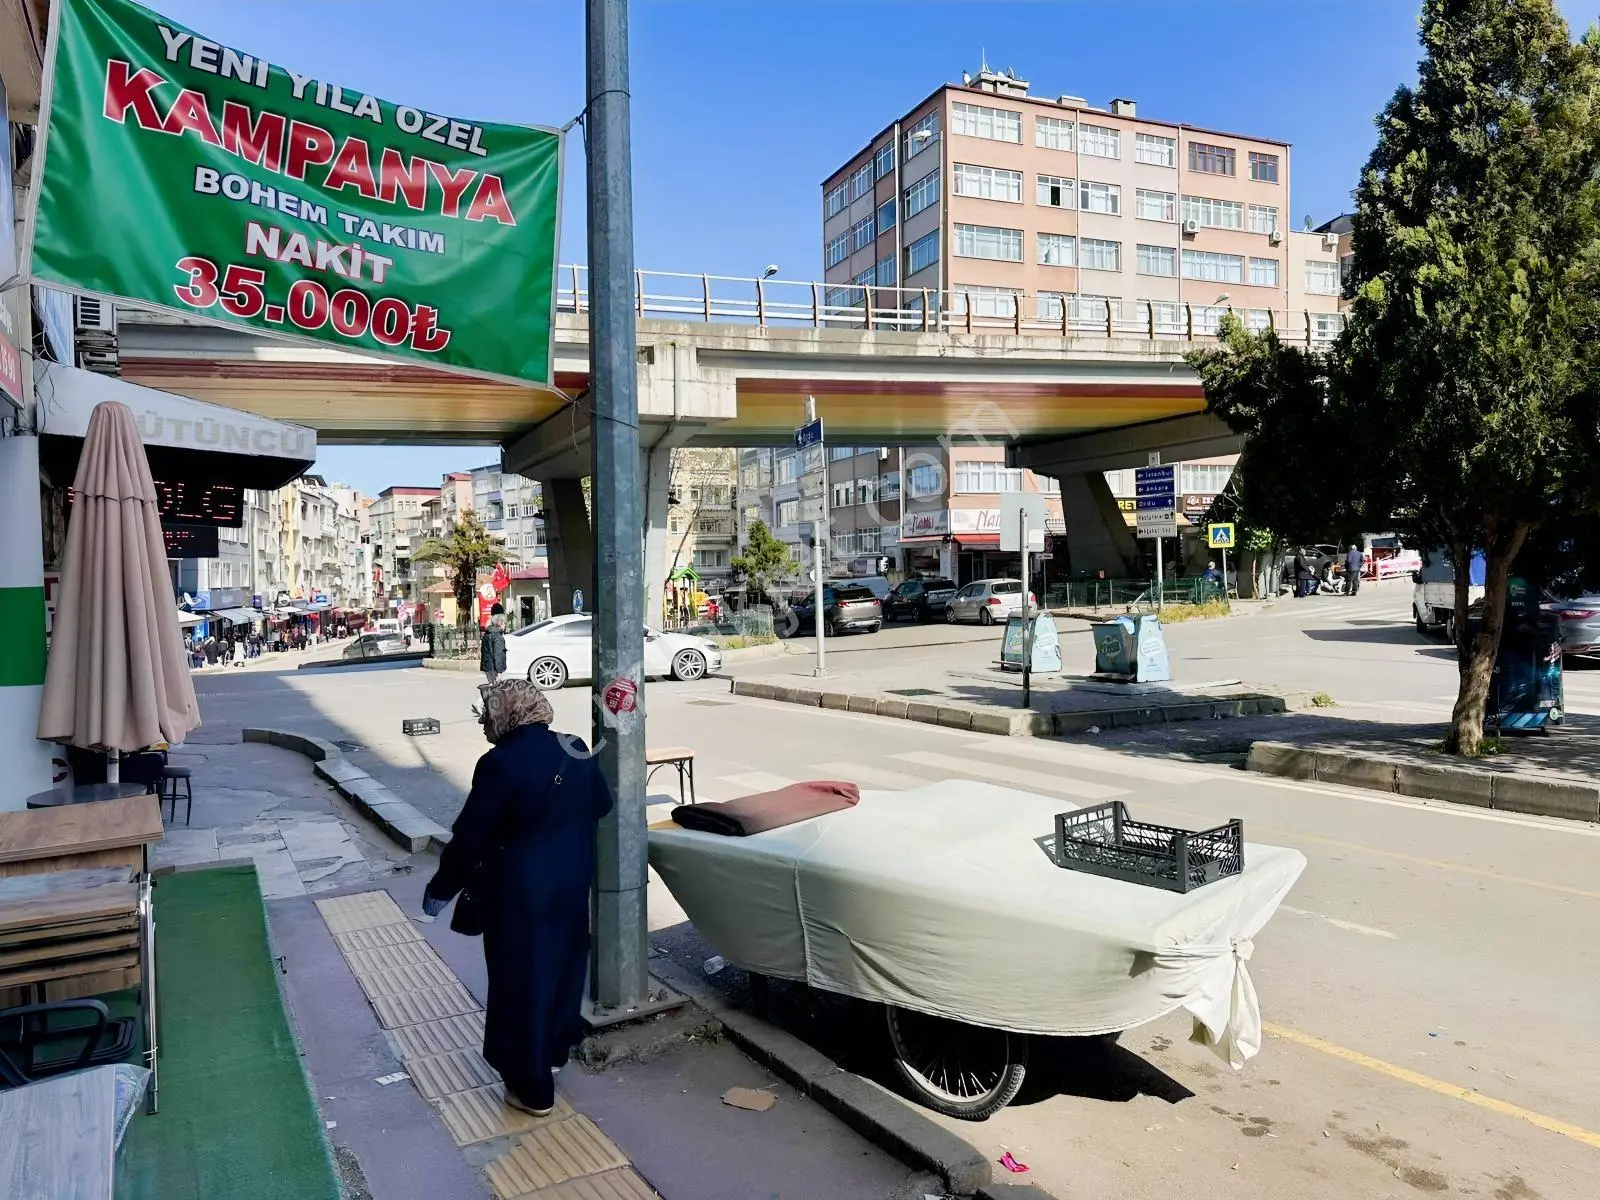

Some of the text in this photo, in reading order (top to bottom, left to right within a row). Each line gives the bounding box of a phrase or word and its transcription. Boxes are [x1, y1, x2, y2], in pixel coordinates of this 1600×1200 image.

[285, 67, 384, 125] YILA
[102, 58, 517, 227] KAMPANYA
[193, 165, 446, 255] BOHEM TAKIM
[245, 220, 393, 284] NAKİT
[173, 256, 452, 352] 35.000₺
[136, 410, 306, 455] ÜTÜNCÜ
